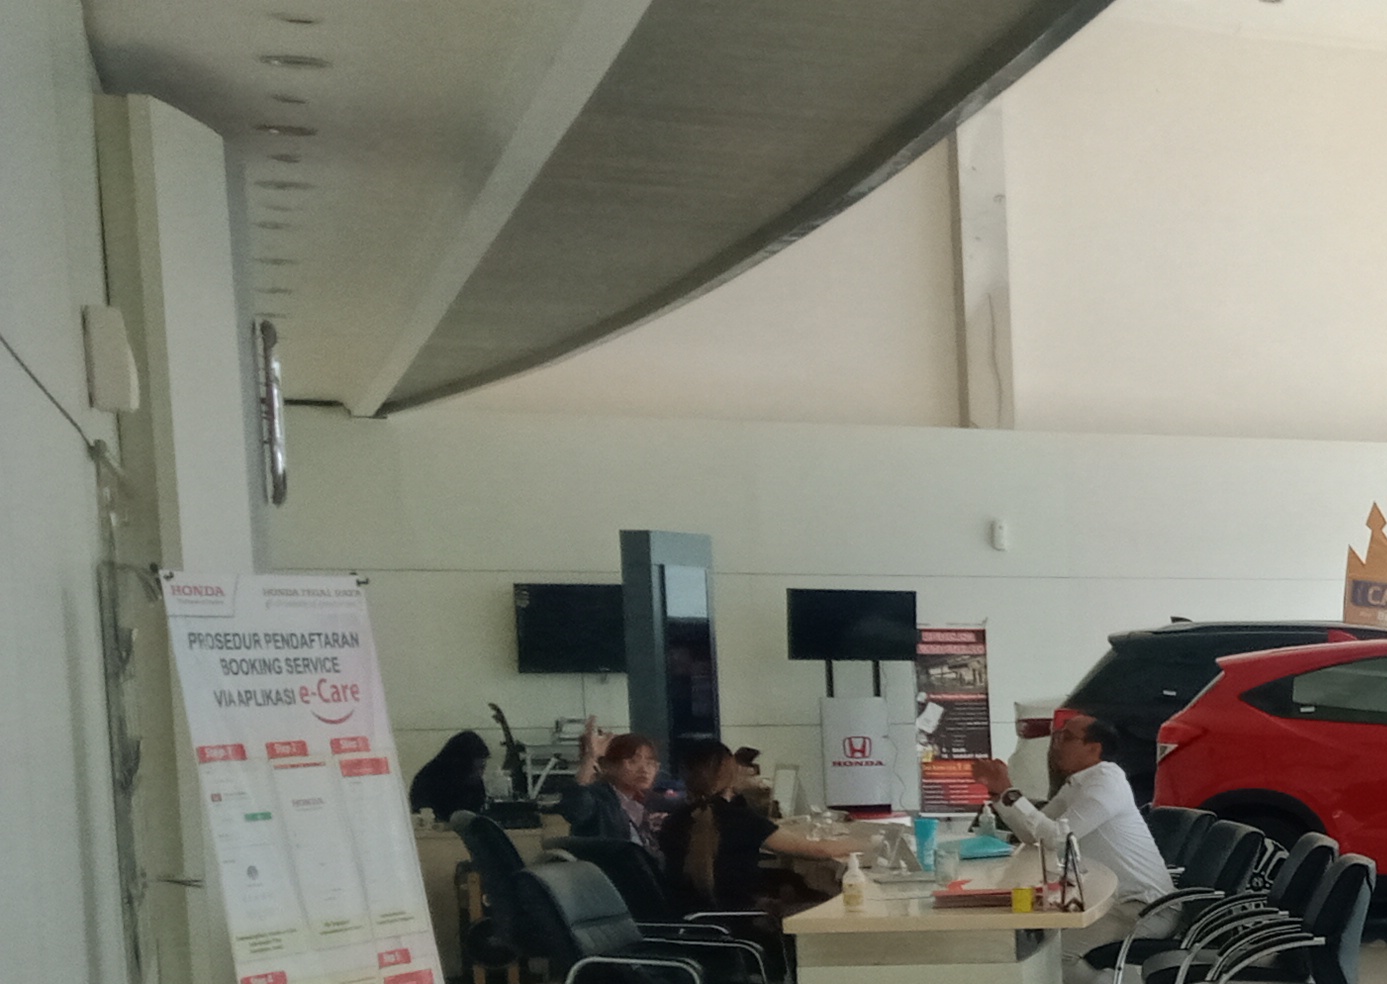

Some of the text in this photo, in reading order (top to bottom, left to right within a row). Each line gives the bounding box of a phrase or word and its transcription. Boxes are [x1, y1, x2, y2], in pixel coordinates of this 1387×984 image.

[171, 585, 225, 597] HONDA
[188, 631, 360, 650] PROSEDUR PENDAFTARAN
[219, 656, 341, 676] BOOKING SERVICE
[238, 688, 296, 707] APLIKASI
[299, 678, 361, 704] e-Care
